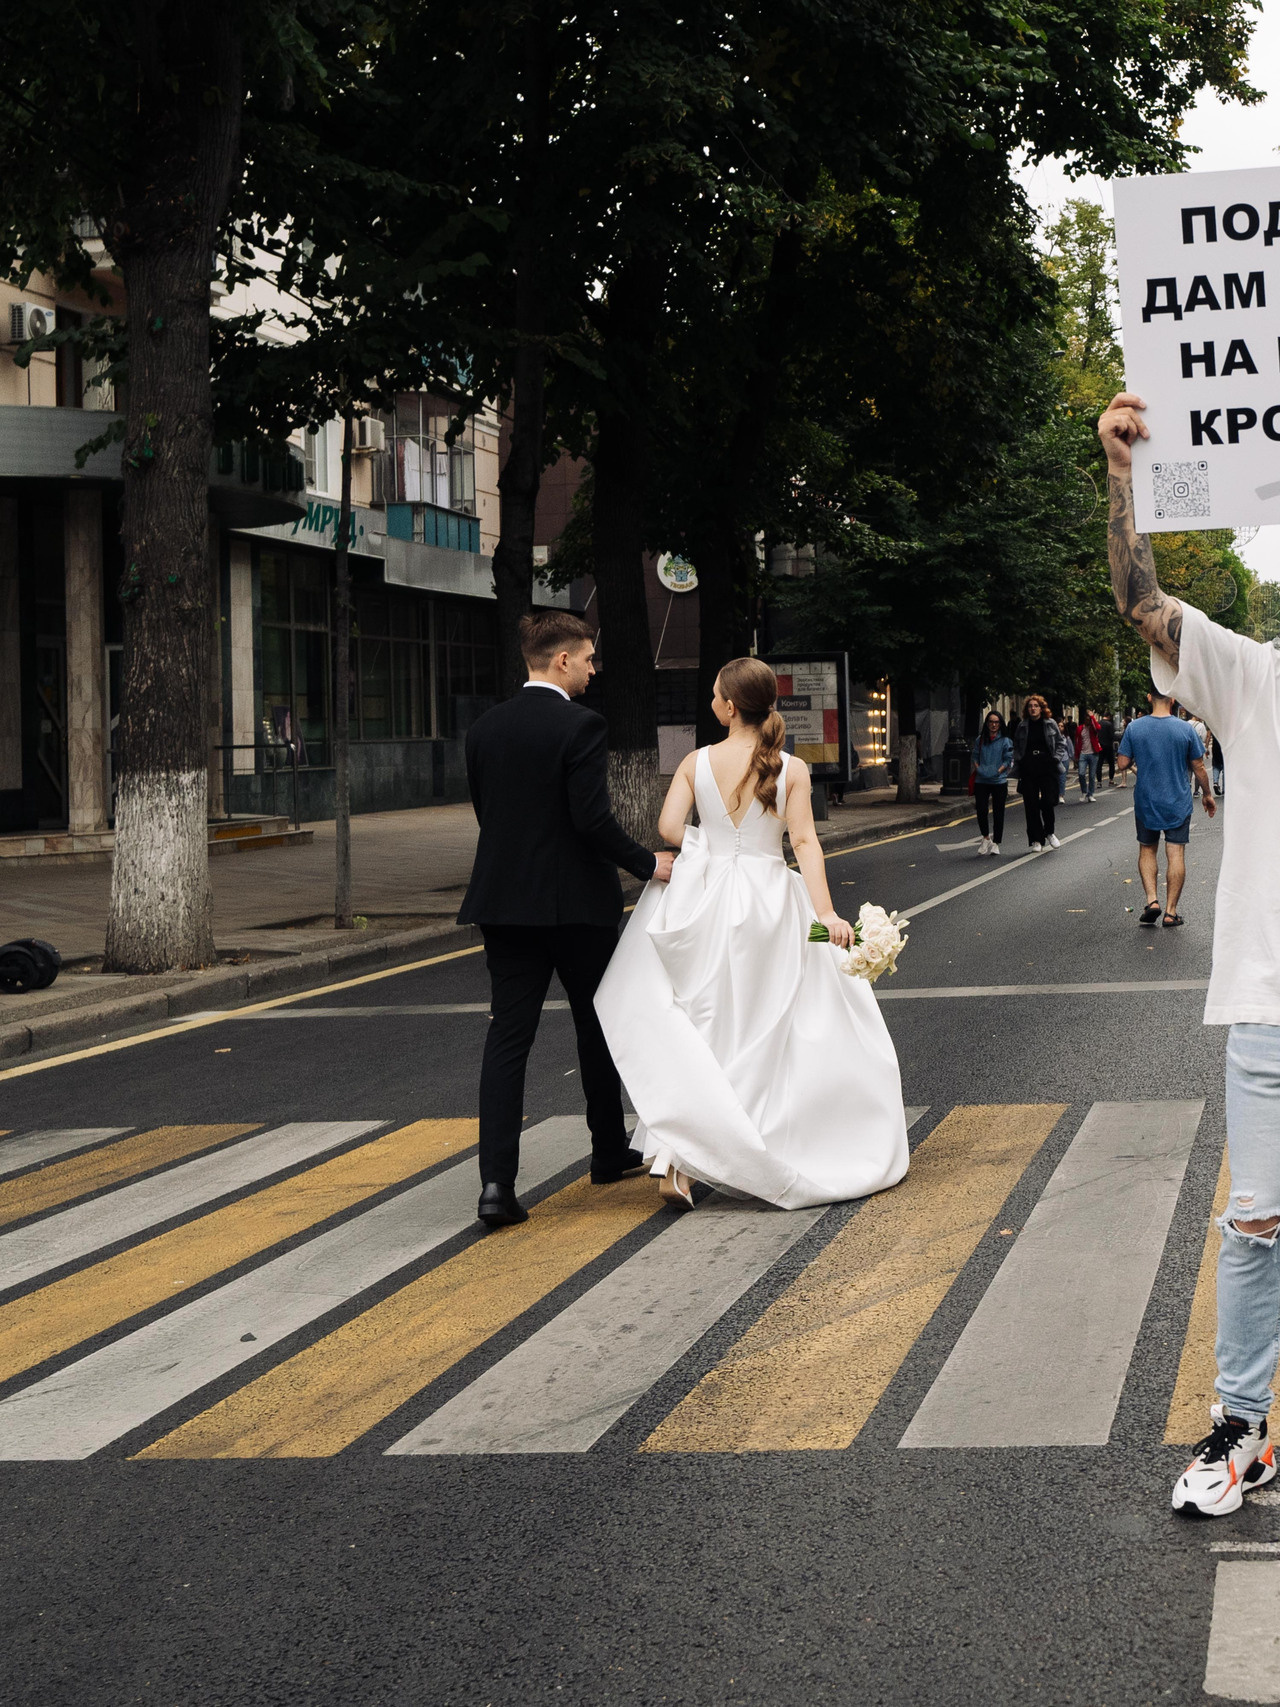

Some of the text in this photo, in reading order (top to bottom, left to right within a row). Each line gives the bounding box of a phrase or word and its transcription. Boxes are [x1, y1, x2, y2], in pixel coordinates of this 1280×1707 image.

[1141, 270, 1266, 324] ДАМ
[1180, 338, 1259, 379] НА
[781, 699, 808, 707] Контур
